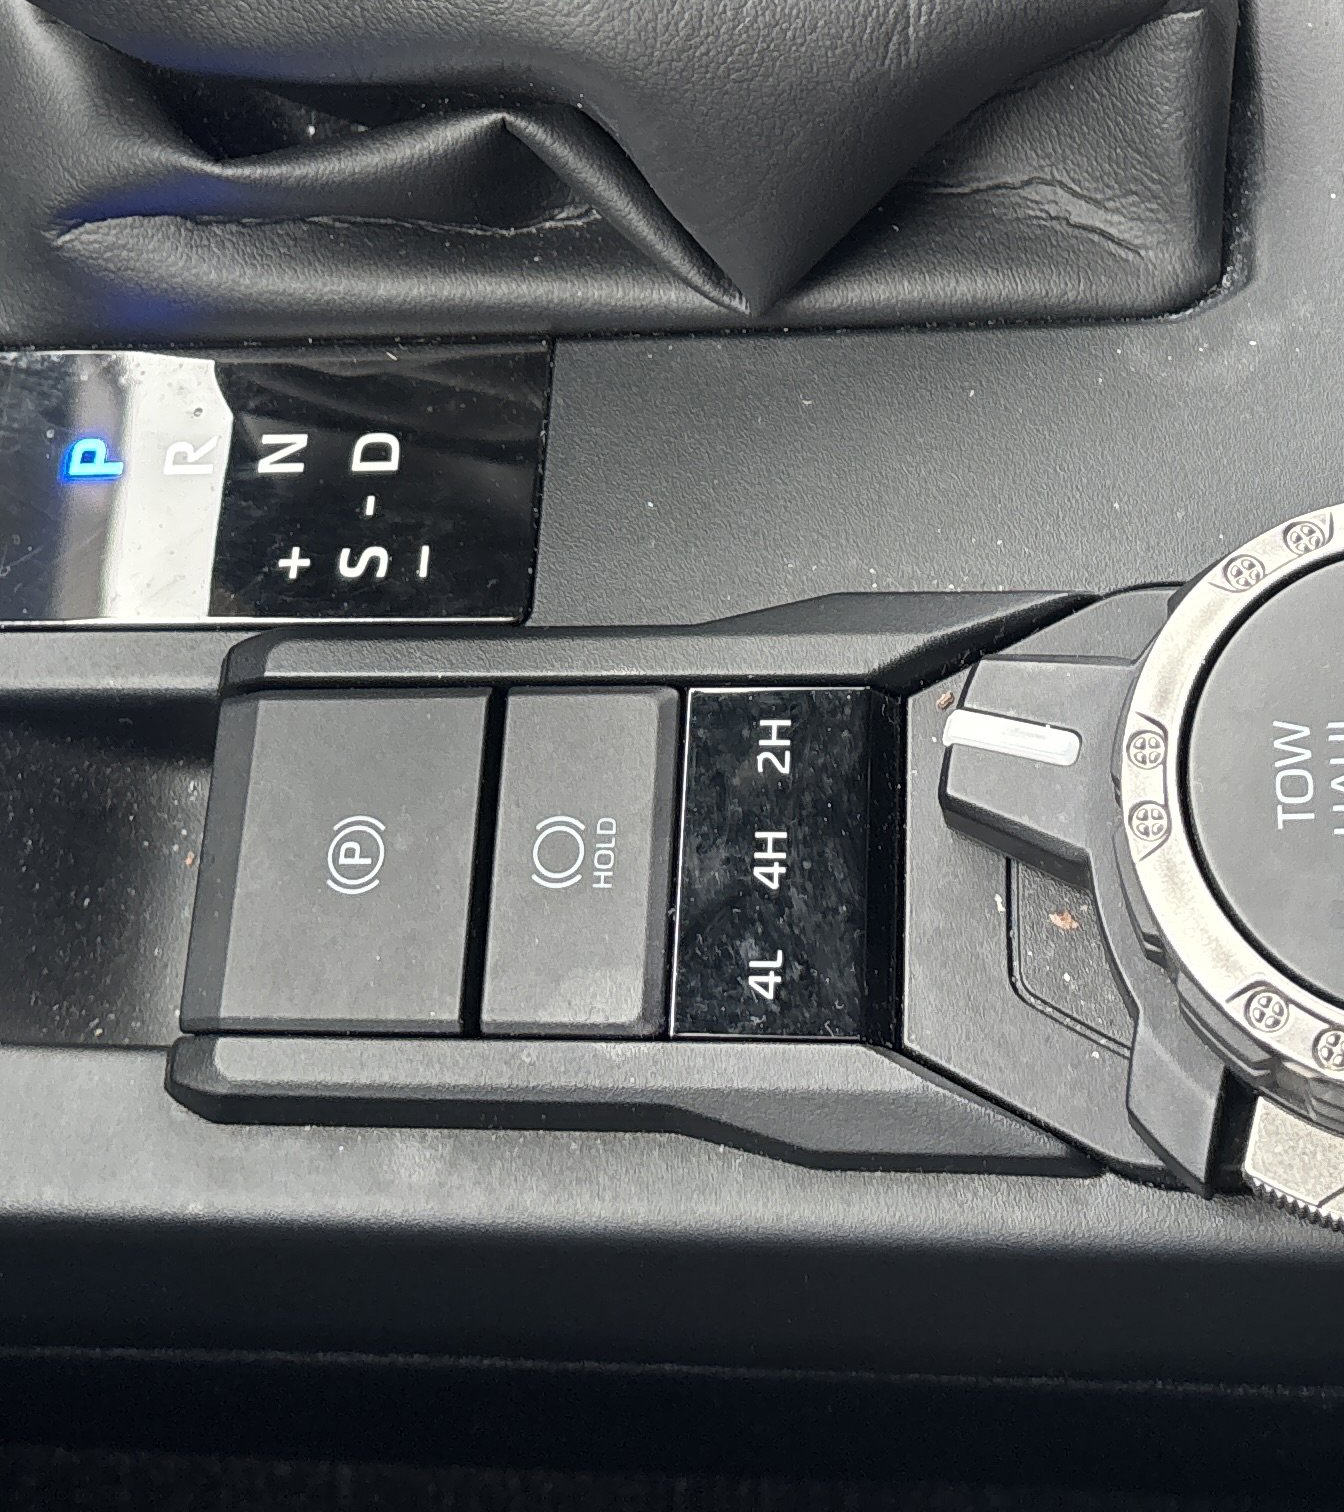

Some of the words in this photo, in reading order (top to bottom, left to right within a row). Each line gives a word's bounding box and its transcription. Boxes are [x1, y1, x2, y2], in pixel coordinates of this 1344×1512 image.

[67, 437, 124, 478] P
[164, 436, 218, 475] R
[259, 433, 309, 473] N
[352, 433, 401, 472] D
[340, 545, 388, 578] S
[757, 719, 792, 774] 2H
[1273, 720, 1315, 830] TOW
[593, 817, 617, 888] HOLD
[753, 831, 789, 890] 4H
[750, 949, 784, 1000] 4L
